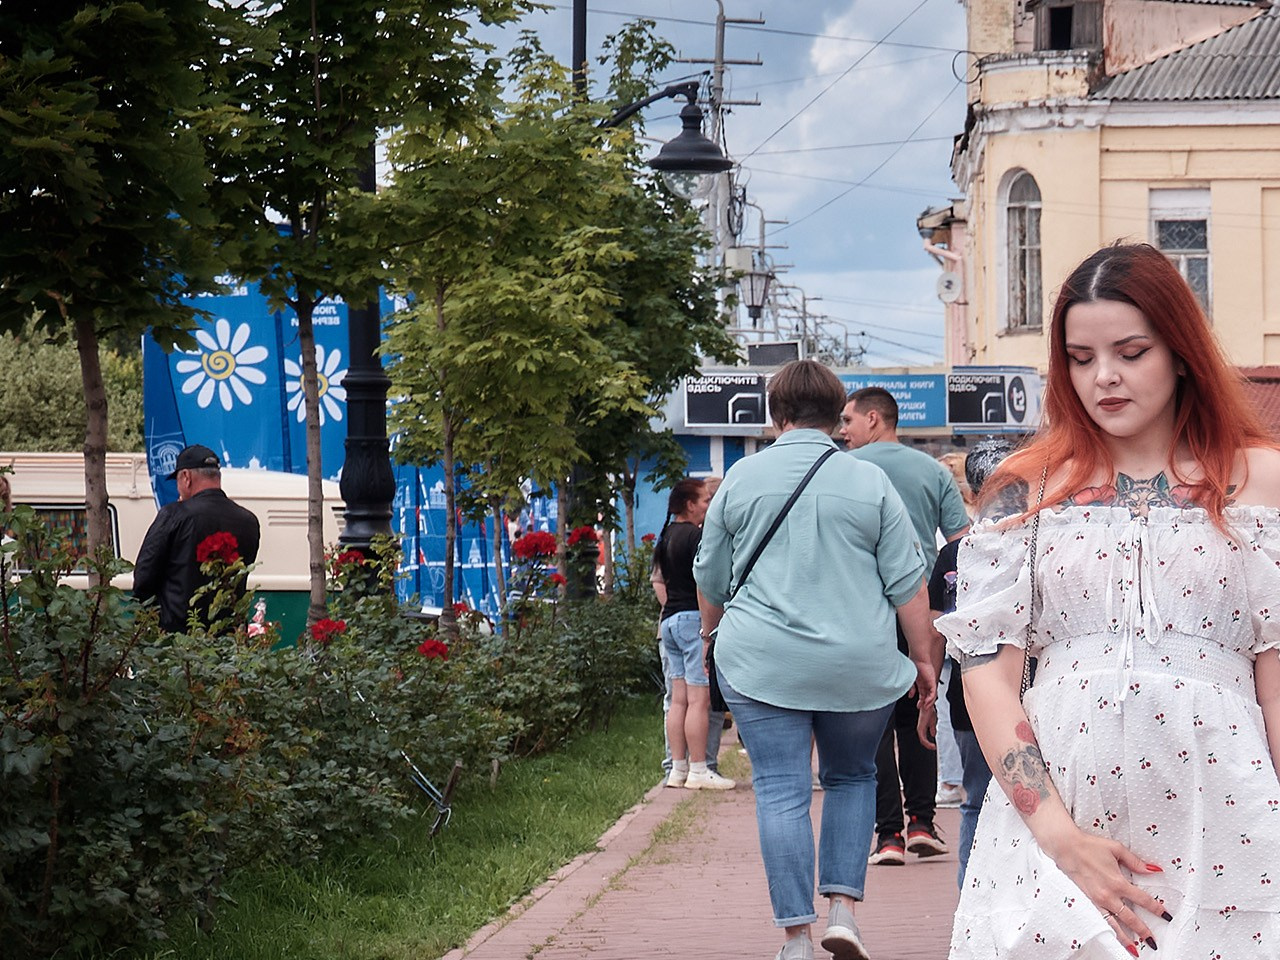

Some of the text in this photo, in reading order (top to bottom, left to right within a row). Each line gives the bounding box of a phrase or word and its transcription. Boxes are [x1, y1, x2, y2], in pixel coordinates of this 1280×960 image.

[687, 376, 759, 386] ПОДКЛЮЧИТЕ
[867, 380, 907, 390] ЖУРНАЛЫ
[909, 381, 935, 389] КНИГИ
[949, 376, 1000, 385] ПОДКЛЮЧИТЕ
[687, 384, 722, 393] ЗДЕСЬ
[949, 384, 977, 392] ЗДЕСЬ
